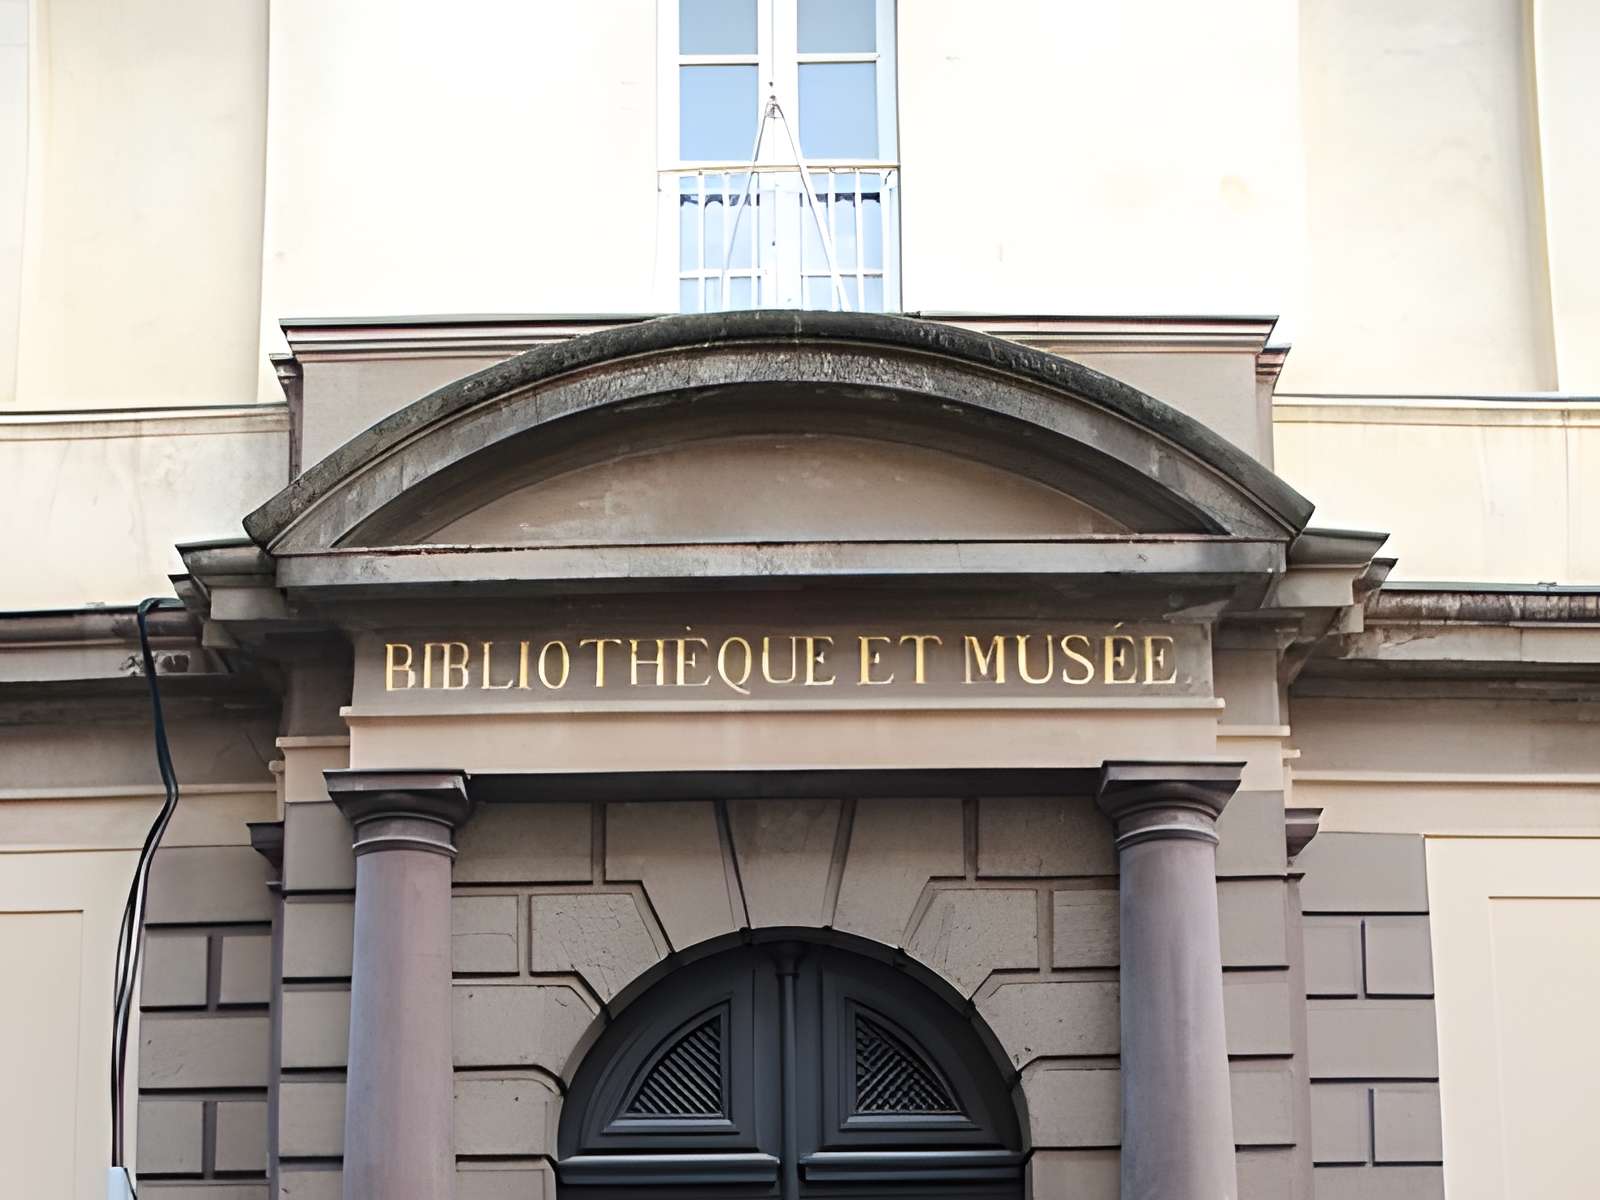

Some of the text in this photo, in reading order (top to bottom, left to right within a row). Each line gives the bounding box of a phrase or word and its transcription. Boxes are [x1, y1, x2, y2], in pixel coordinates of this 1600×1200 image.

[385, 622, 1178, 695] BIBLIOTHÈQUE ET MUSÉE
